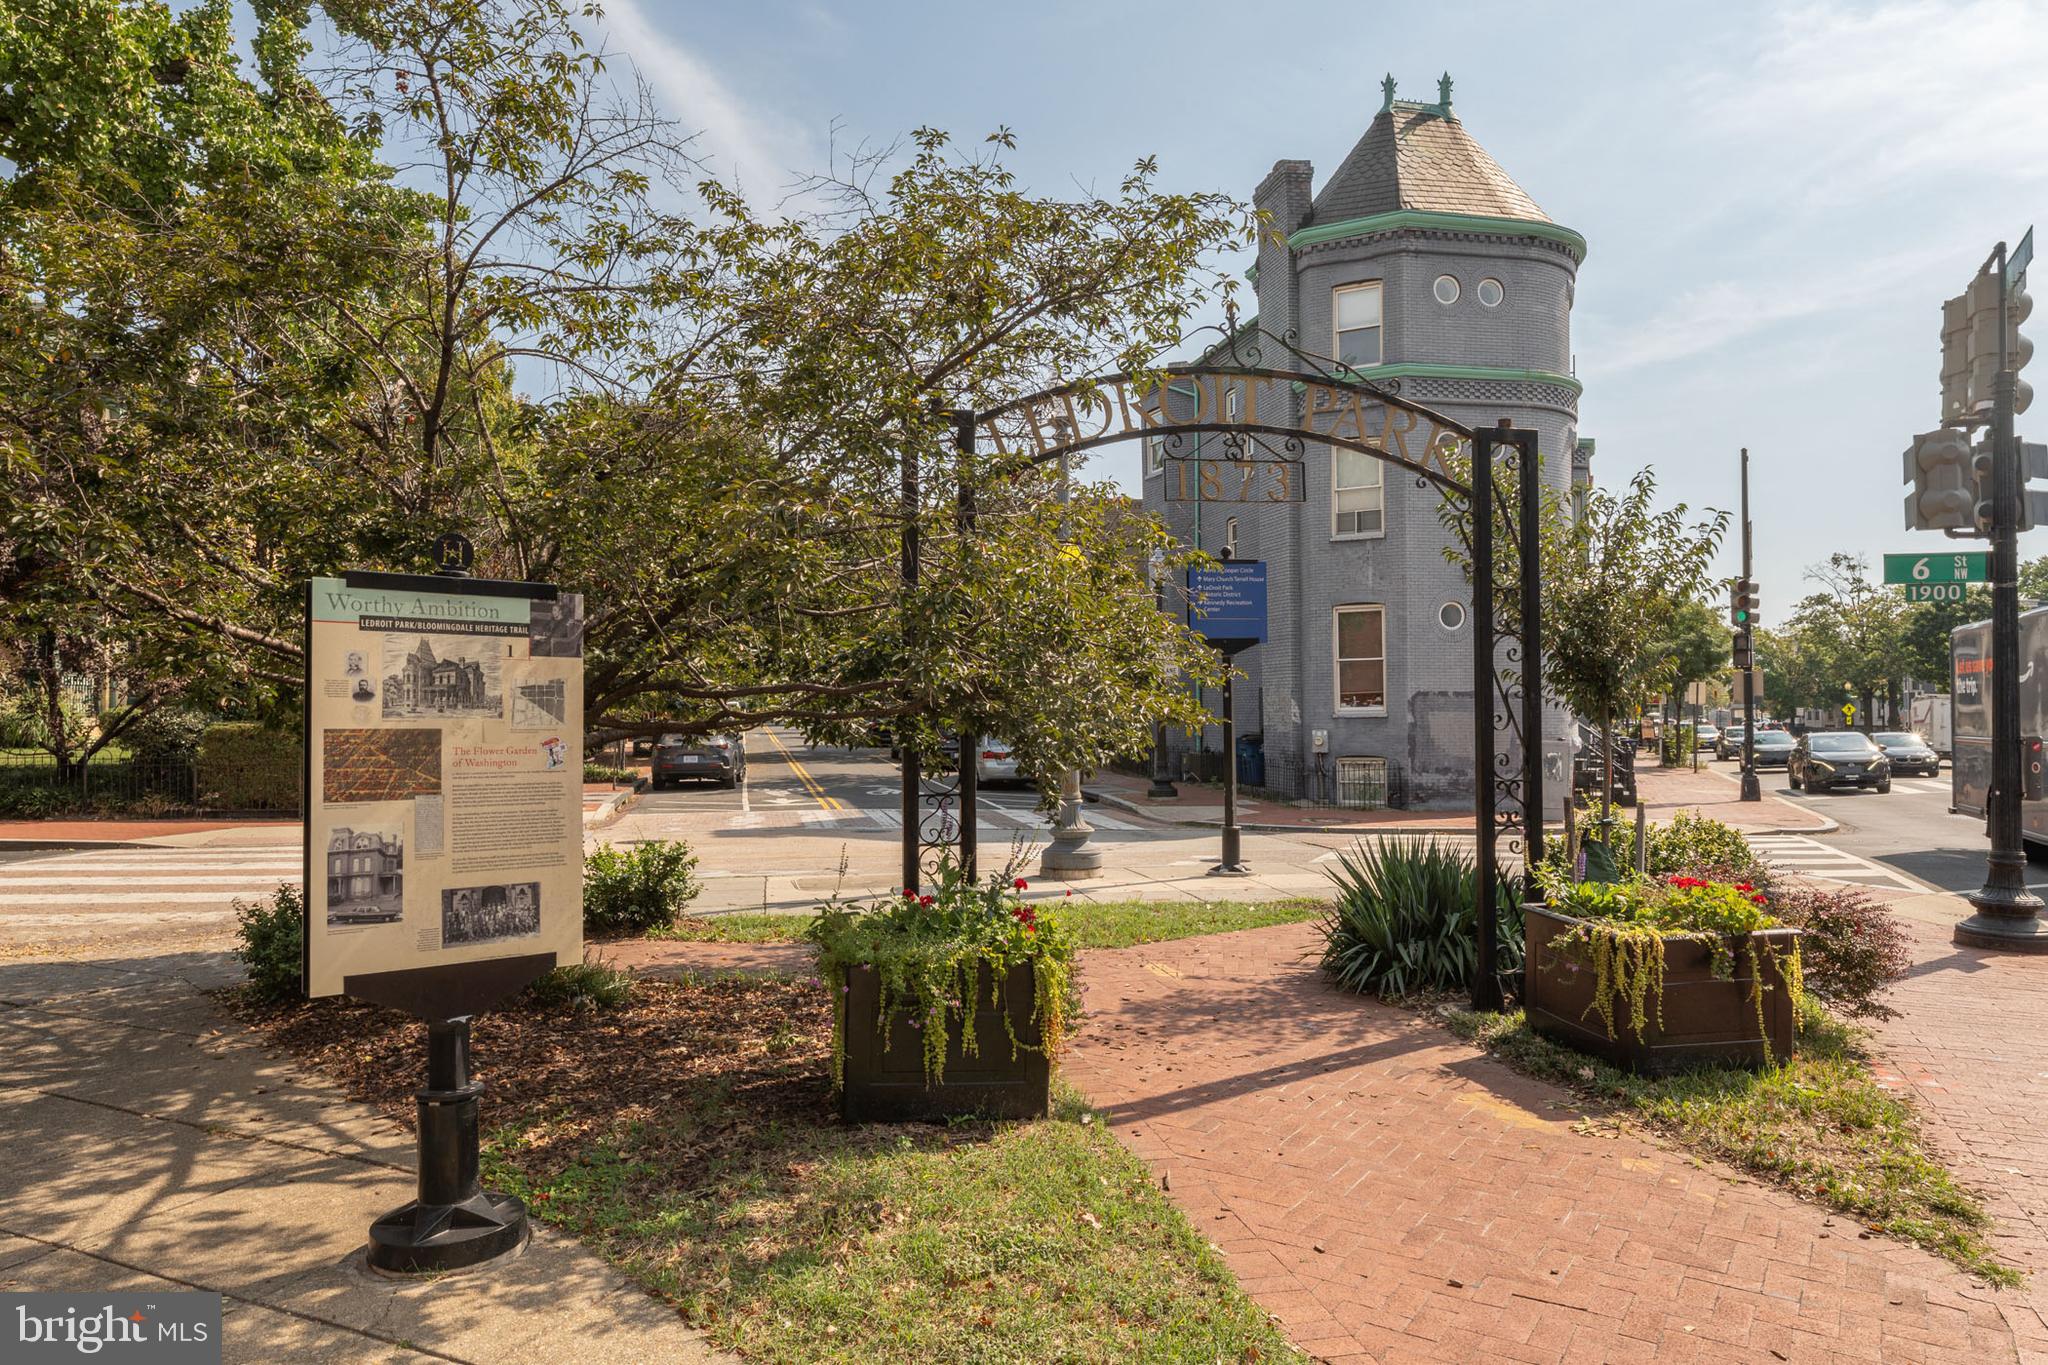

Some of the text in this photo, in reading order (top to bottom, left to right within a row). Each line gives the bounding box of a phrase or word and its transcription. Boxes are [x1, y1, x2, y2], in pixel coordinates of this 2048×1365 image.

[1303, 382, 1470, 481] PARK
[1177, 462, 1291, 502] 1873
[1912, 556, 1968, 580] 6 St
[1954, 568, 1969, 580] NW
[1910, 584, 1961, 600] 1900
[325, 592, 500, 619] Worthy Ambition
[361, 619, 529, 634] LEDROIT PARK/BLOOMINGDALE HERITAGE TRAIL
[508, 644, 512, 657] 1
[452, 745, 538, 756] The Flower Garden
[452, 758, 517, 769] of Washington
